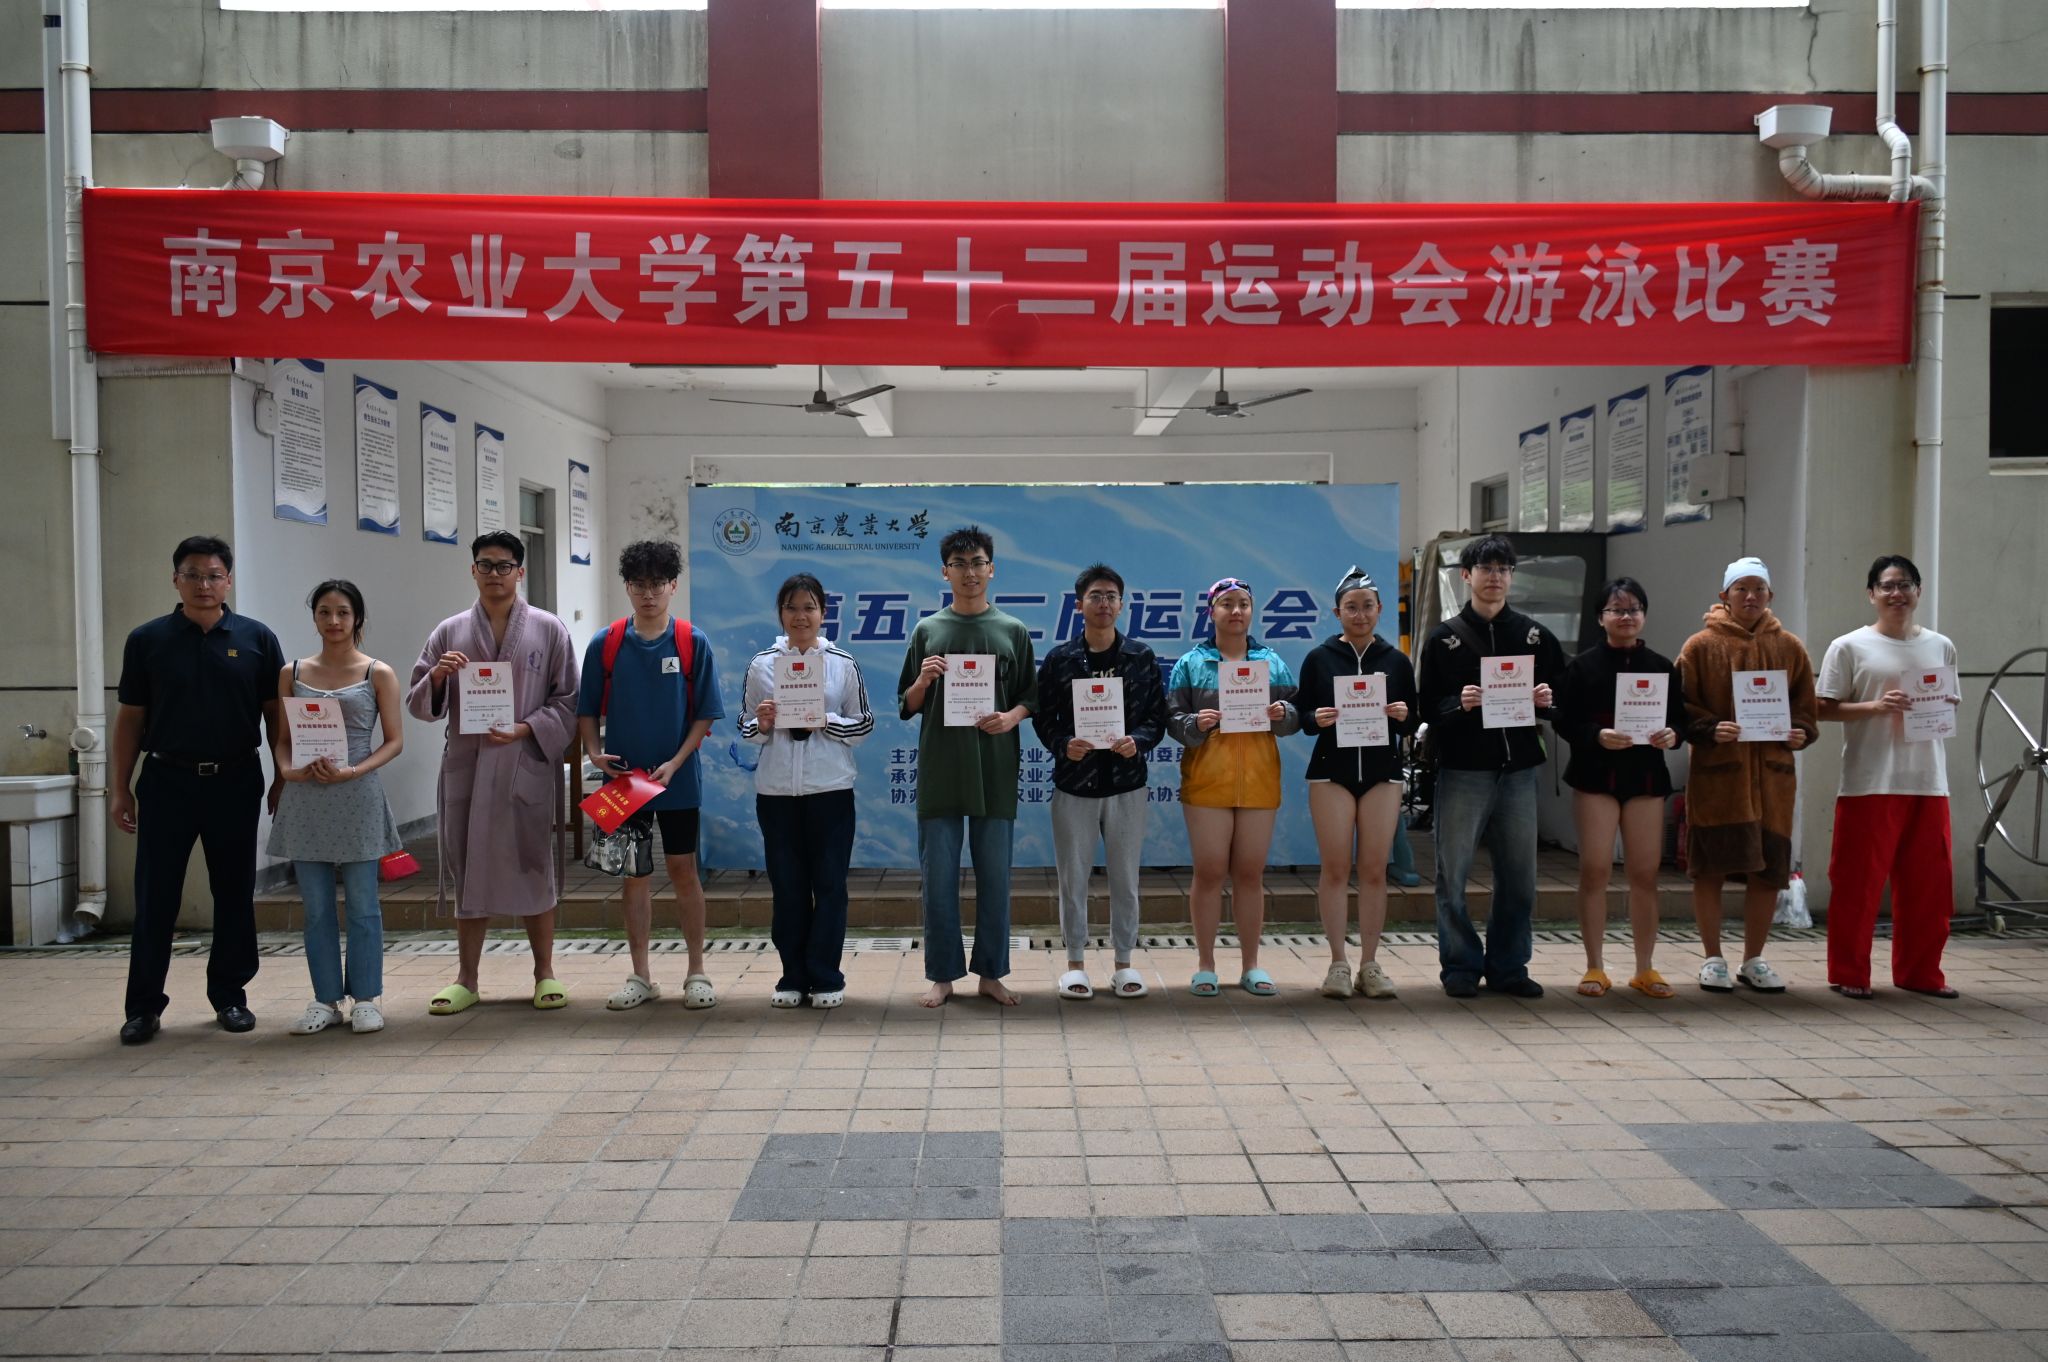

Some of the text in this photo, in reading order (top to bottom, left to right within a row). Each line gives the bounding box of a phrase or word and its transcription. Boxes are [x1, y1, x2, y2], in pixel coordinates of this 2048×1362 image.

[163, 228, 1839, 328] 南京农业大学第五十二届运动会游泳比赛
[781, 542, 921, 552] NANJING AGRICULTURAL UNIVERSITY
